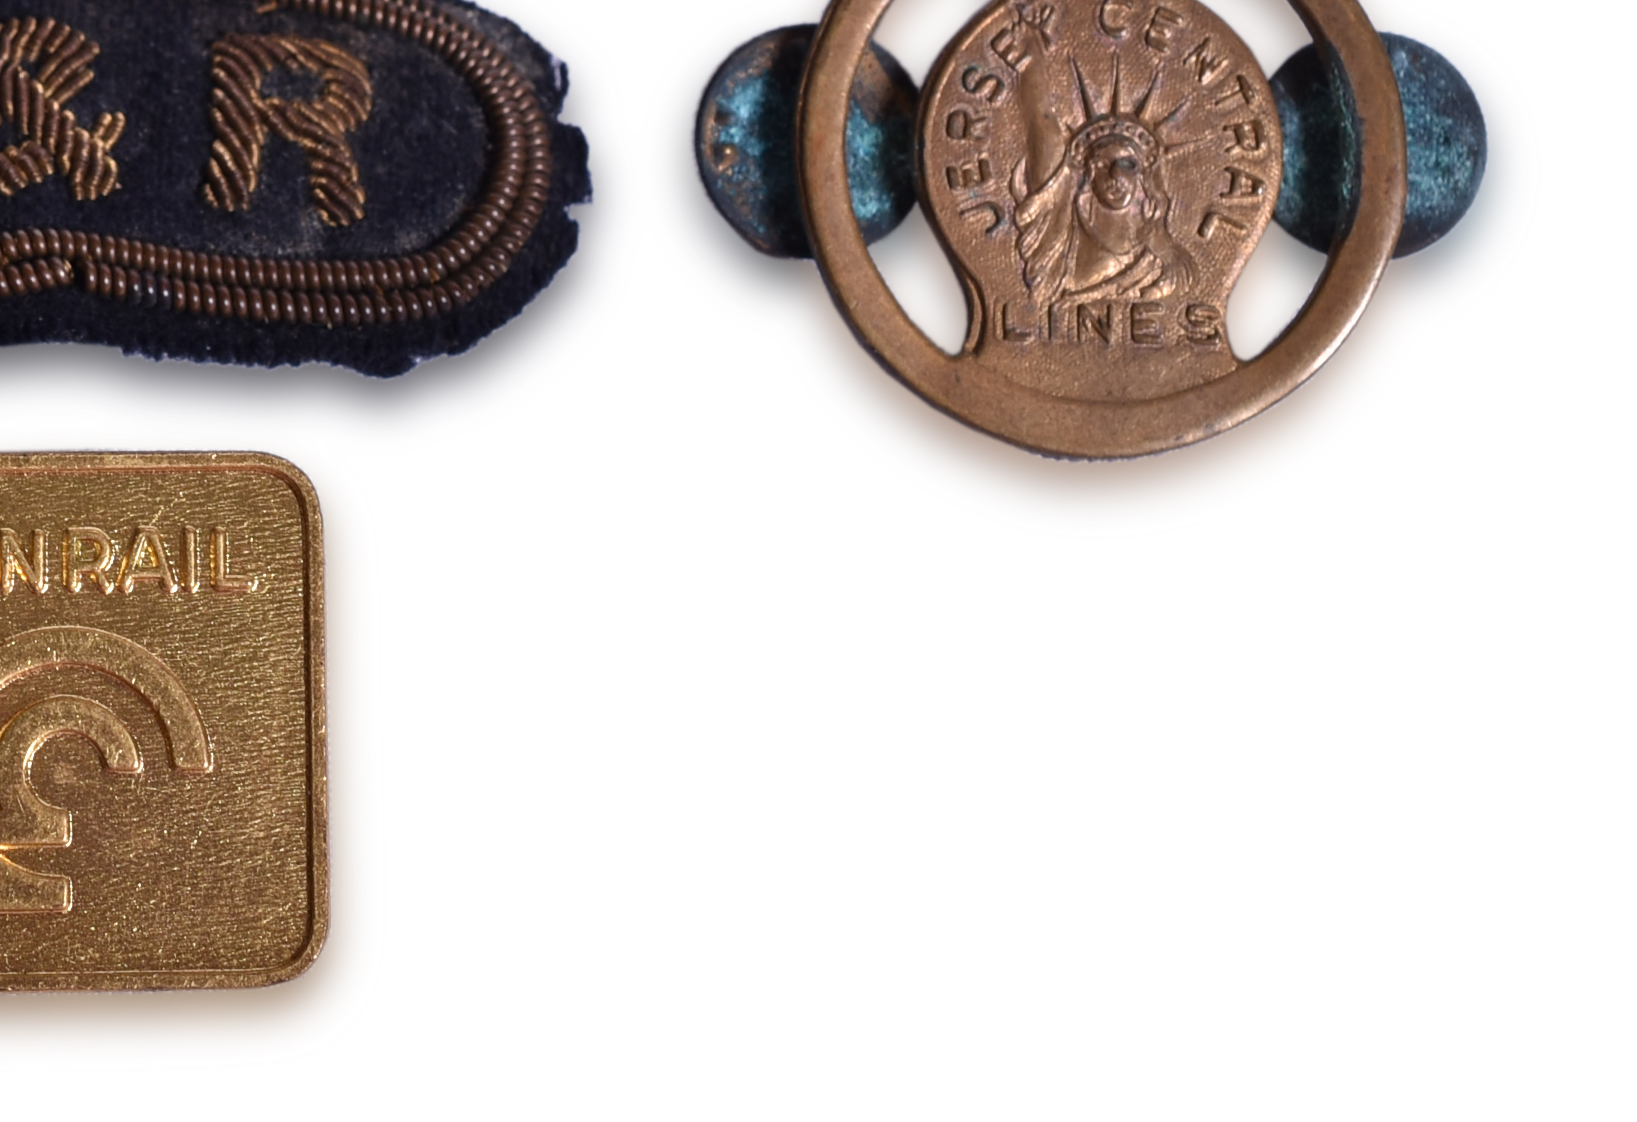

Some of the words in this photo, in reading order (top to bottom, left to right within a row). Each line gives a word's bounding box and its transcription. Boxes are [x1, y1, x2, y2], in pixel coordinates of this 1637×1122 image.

[201, 32, 374, 228] R
[944, 2, 1058, 238] JERSEY
[993, 302, 1224, 347] LINES
